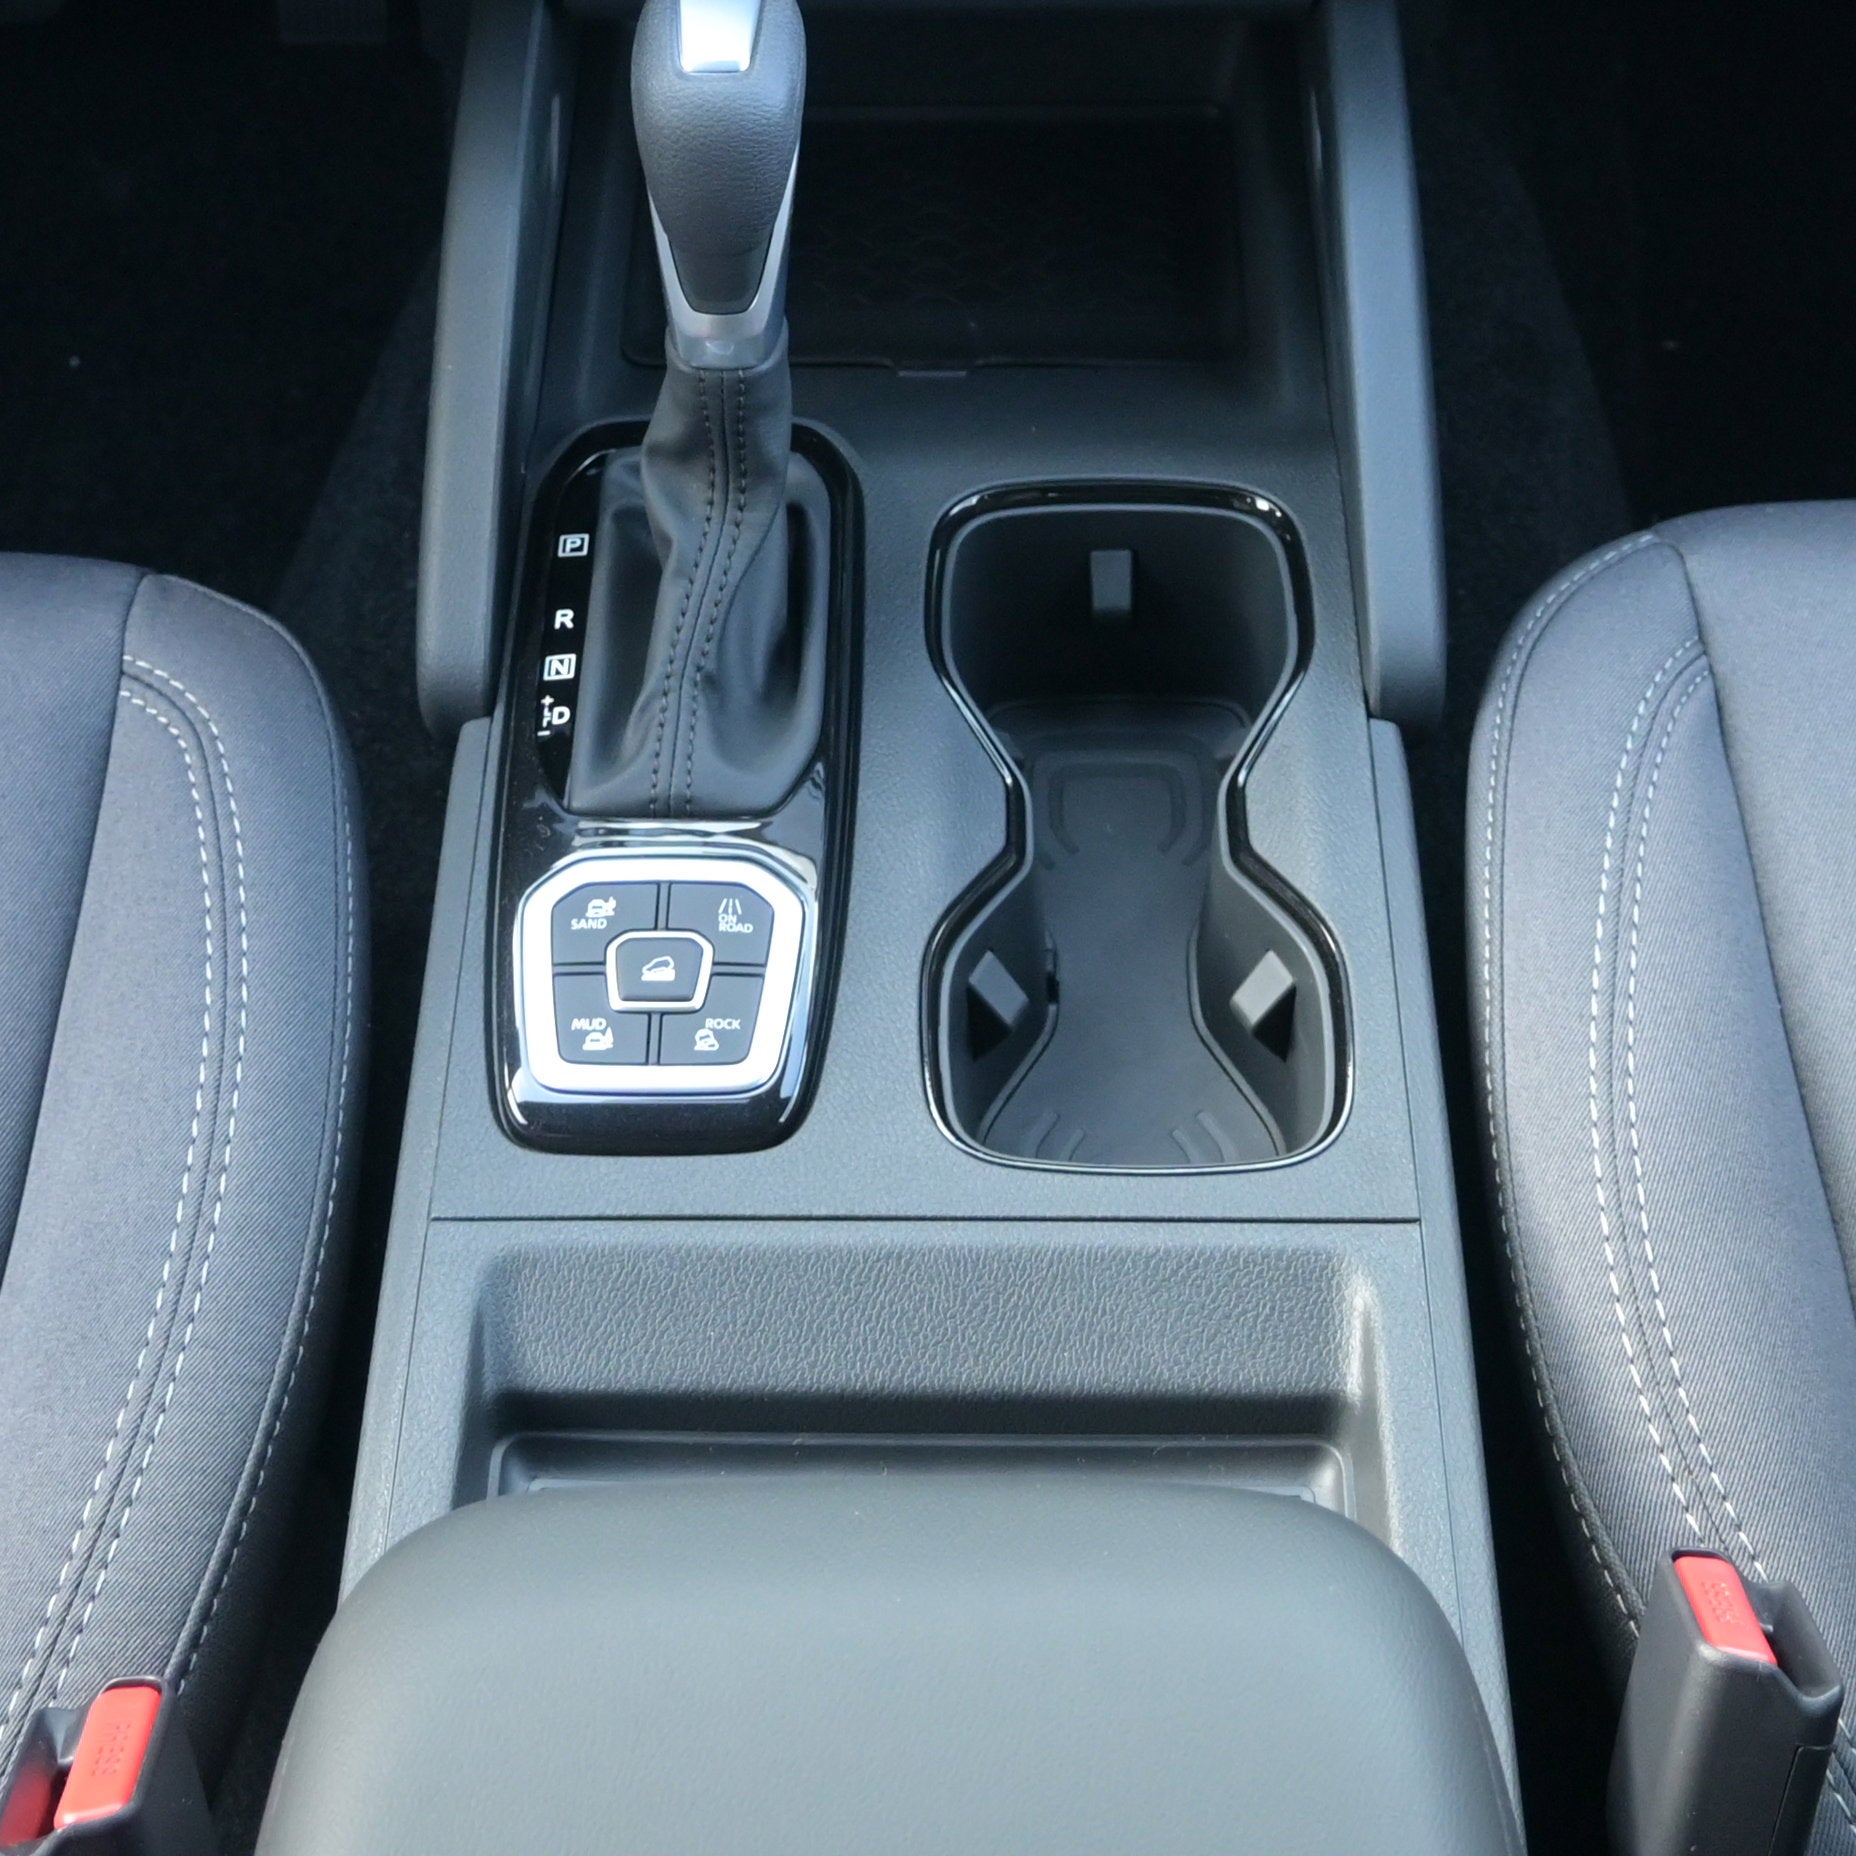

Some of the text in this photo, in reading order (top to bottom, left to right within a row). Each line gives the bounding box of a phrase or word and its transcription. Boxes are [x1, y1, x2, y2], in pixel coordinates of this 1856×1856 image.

[565, 538, 581, 553] P
[554, 609, 574, 629] R
[550, 659, 569, 676] N
[552, 706, 571, 724] D
[571, 918, 607, 930] SAND
[718, 914, 737, 923] ON
[718, 922, 753, 933] ROAD
[571, 1018, 607, 1030] MUD
[705, 1018, 741, 1029] ROCK
